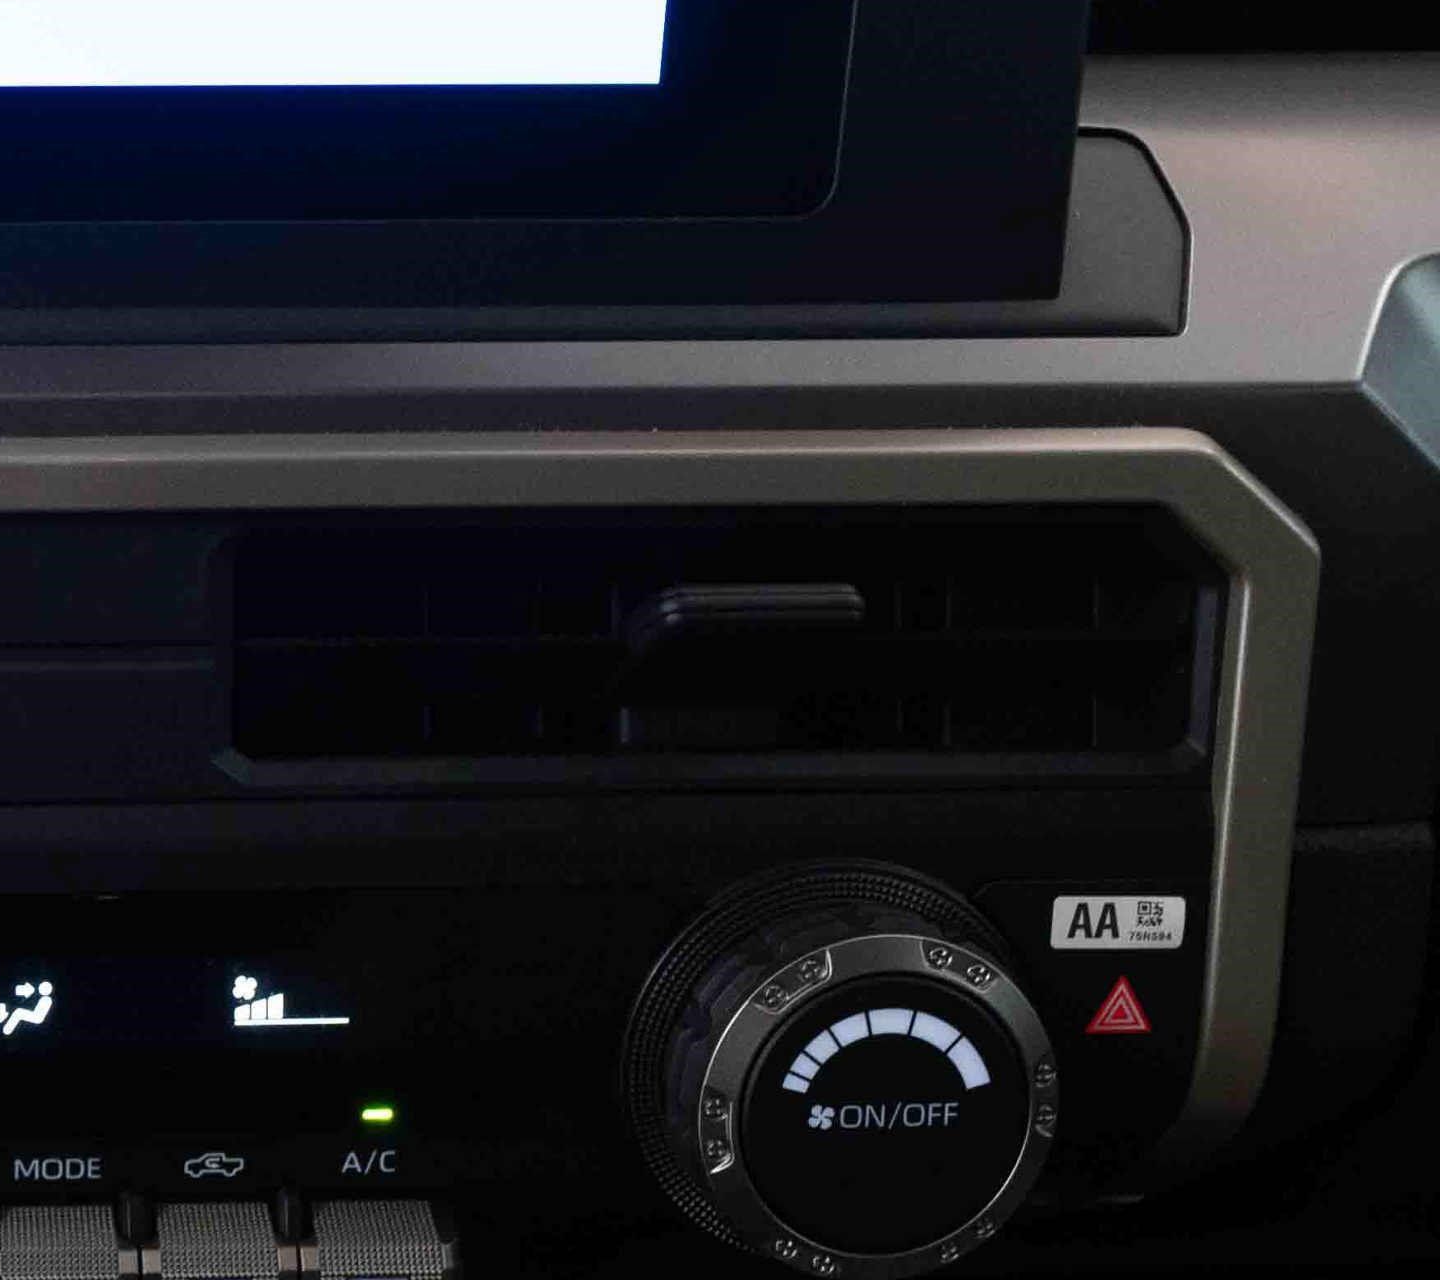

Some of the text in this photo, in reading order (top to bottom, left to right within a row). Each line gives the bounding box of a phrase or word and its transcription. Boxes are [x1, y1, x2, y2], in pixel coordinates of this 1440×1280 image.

[1067, 901, 1120, 939] AA
[839, 1101, 959, 1130] ON/OFF
[13, 1156, 102, 1180] MODE
[342, 1150, 396, 1174] A/C
